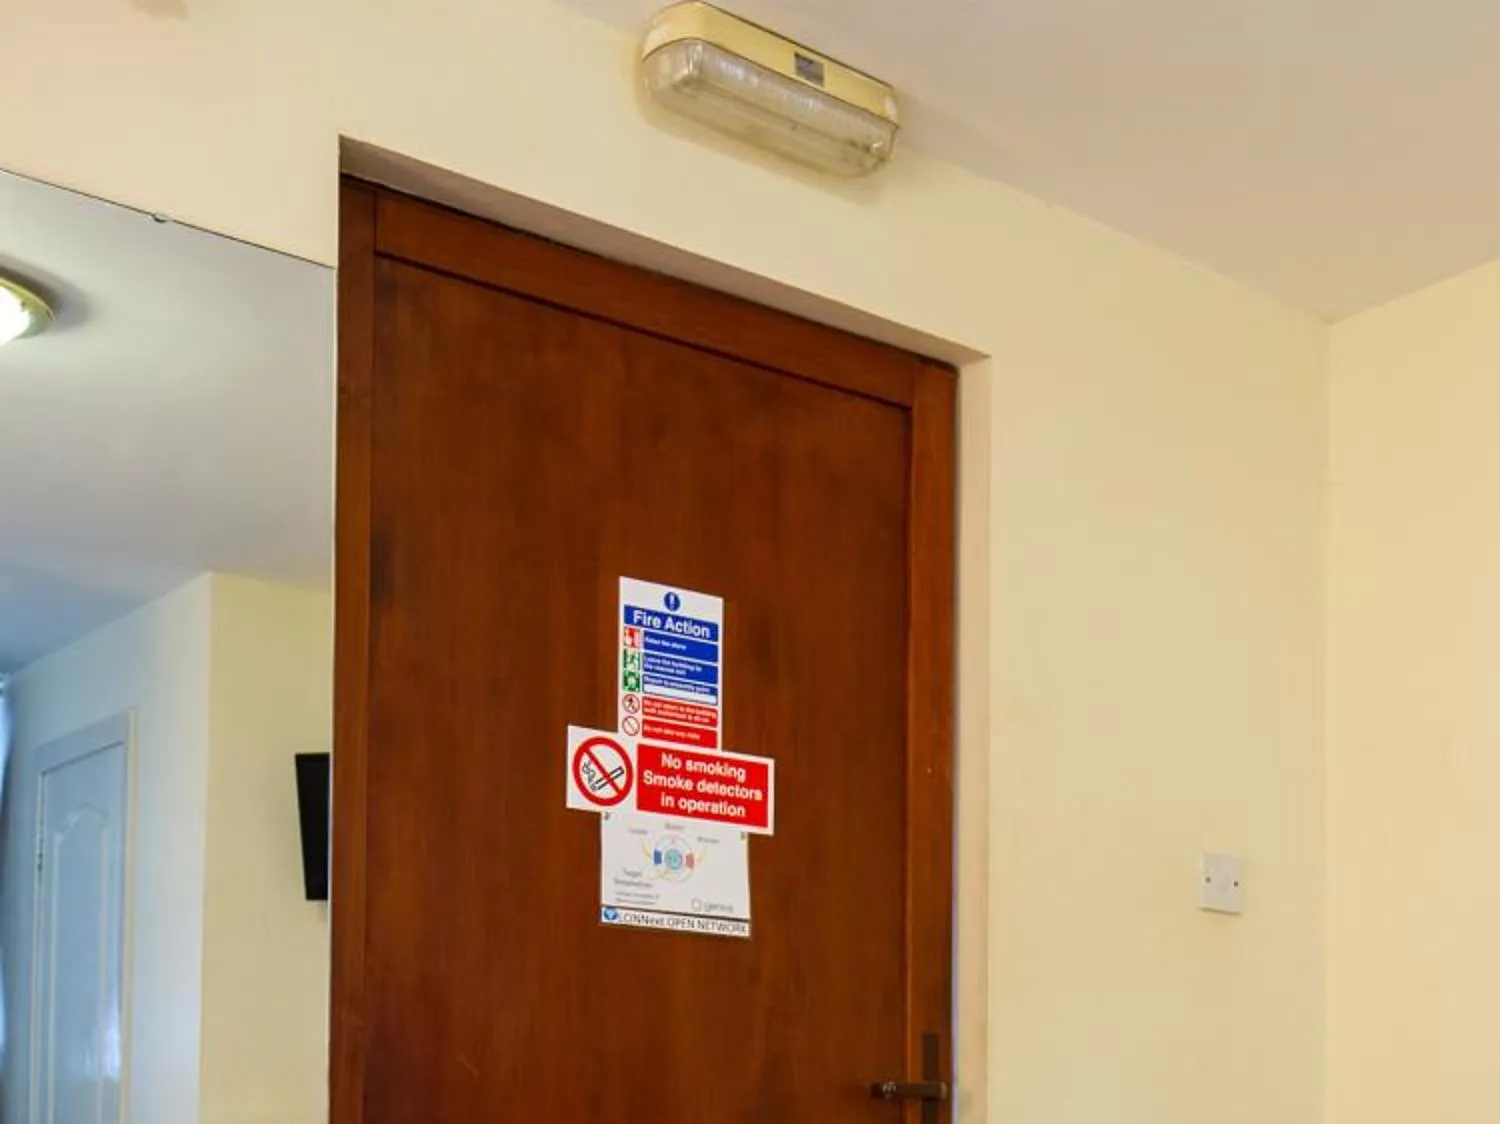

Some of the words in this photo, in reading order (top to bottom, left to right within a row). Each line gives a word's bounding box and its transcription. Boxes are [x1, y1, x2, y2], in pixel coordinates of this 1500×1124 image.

[633, 609, 661, 629] Fire
[664, 617, 711, 639] Action
[661, 752, 680, 768] No
[685, 757, 746, 780] smoking
[643, 771, 693, 791] Smoke
[696, 779, 763, 801] detectors
[660, 792, 675, 808] in
[679, 797, 746, 818] operation
[667, 916, 695, 929] OPEN
[697, 920, 746, 934] NETWORK
